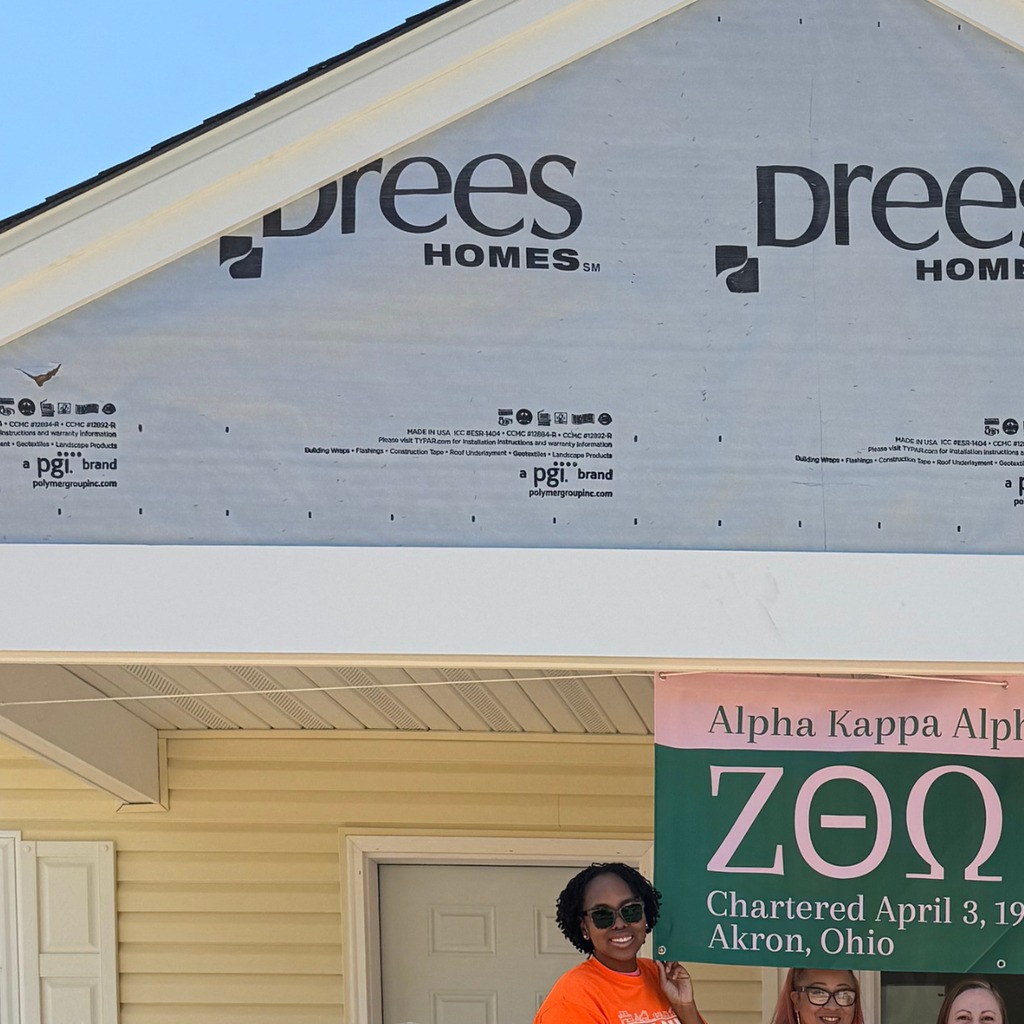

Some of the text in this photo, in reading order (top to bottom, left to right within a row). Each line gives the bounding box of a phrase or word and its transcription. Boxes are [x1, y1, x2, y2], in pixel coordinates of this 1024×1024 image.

[424, 242, 580, 272] HOMES
[407, 428, 427, 436] MADE
[90, 442, 118, 450] Products
[548, 440, 575, 449] warranty
[304, 447, 329, 455] Building
[330, 447, 350, 455] Wraps
[356, 447, 384, 455] Flashings
[389, 447, 428, 456] Construction
[552, 451, 584, 459] Landscape
[585, 451, 613, 459] Products
[22, 460, 30, 469] a
[82, 458, 118, 470] brand
[845, 457, 873, 465] Flashings
[878, 456, 916, 464] Construction
[519, 469, 527, 479] a
[577, 468, 613, 481] brand
[32, 479, 118, 489] polymergroupinc.com
[1004, 479, 1012, 488] a
[528, 487, 613, 498] polymergroupinc.com
[708, 705, 816, 743] Alpha
[828, 709, 942, 746] Kappa
[706, 889, 866, 921] Chartered
[875, 895, 952, 930] April
[962, 900, 986, 929] 3,
[708, 923, 895, 957] Akron, Ohio
